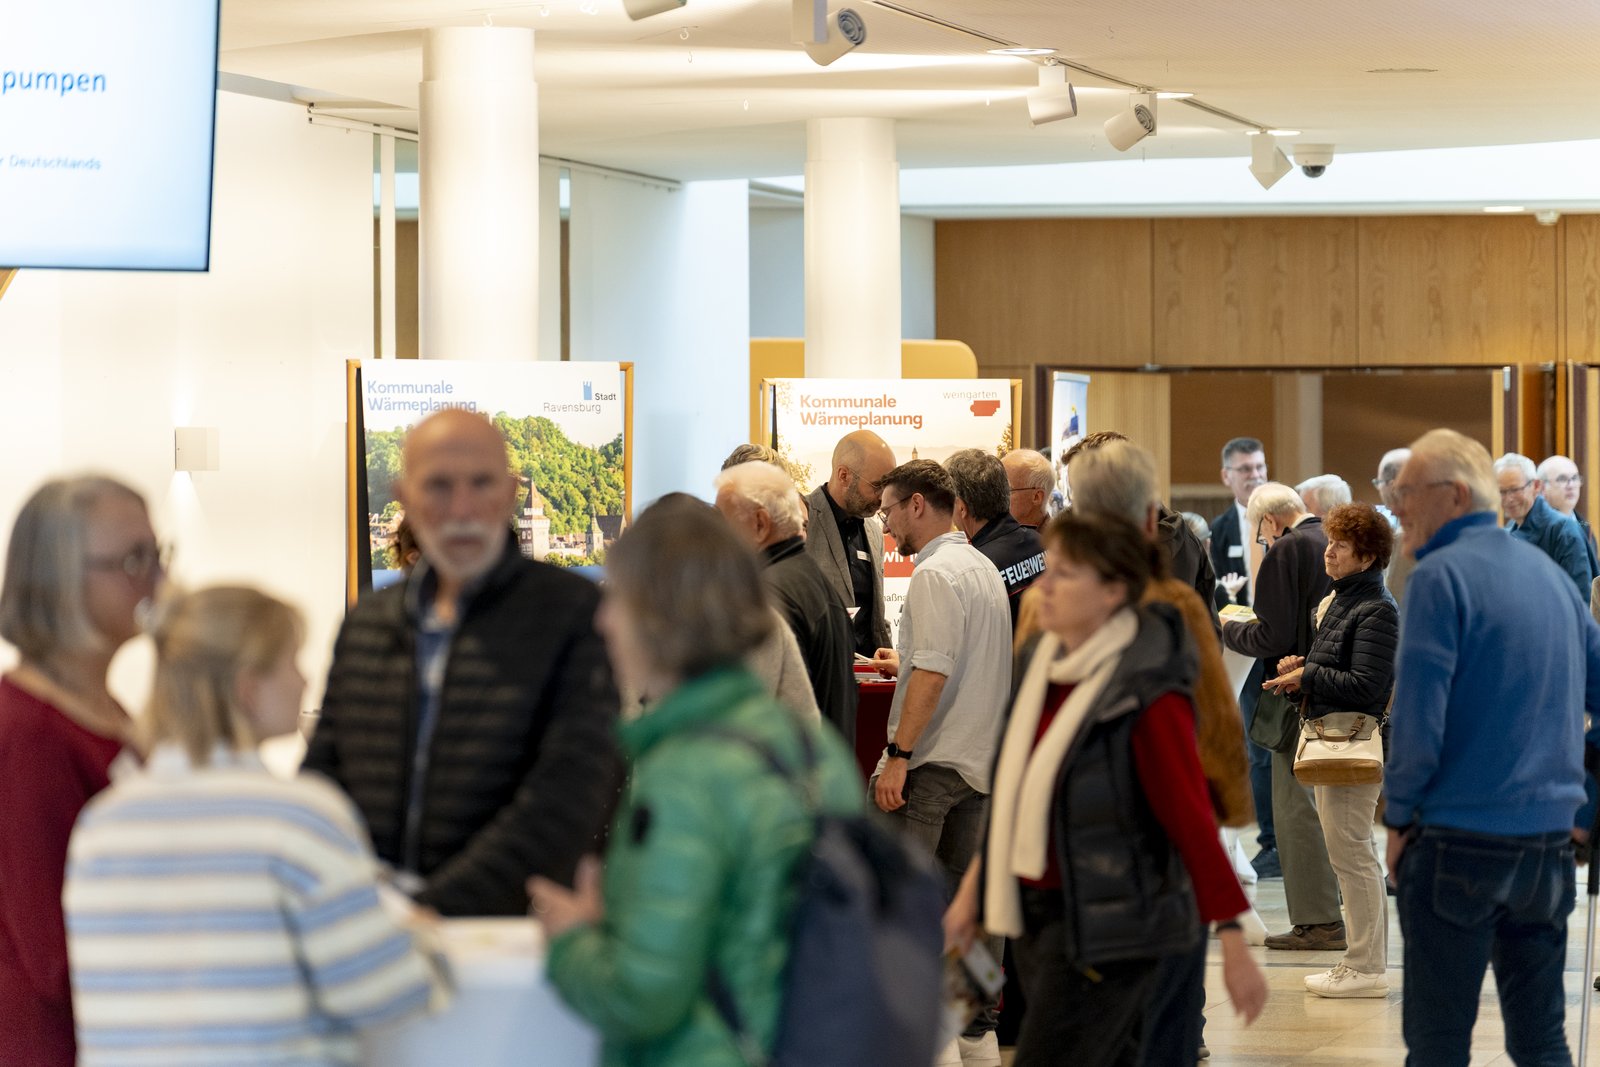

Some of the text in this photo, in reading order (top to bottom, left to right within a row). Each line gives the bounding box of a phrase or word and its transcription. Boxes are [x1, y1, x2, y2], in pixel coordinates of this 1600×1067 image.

[3, 71, 106, 97] pumpen
[367, 380, 454, 394] Kommunale
[594, 392, 617, 401] Stadt
[800, 394, 897, 408] Kommunale
[942, 390, 998, 401] weingarten
[368, 397, 477, 416] Wärmeplanung
[543, 402, 601, 415] Ravensburg
[800, 411, 923, 430] Wärmeplanung
